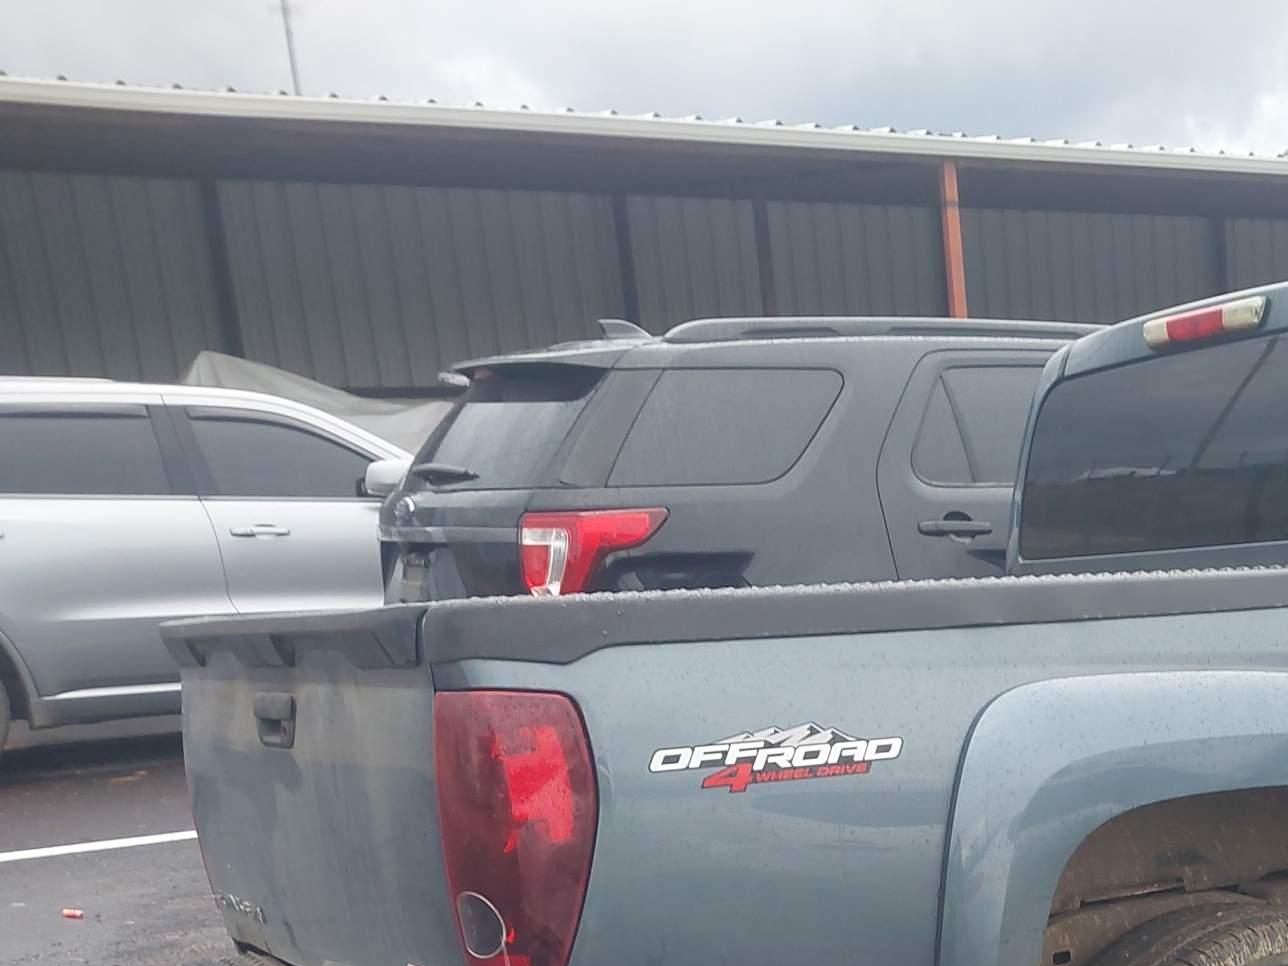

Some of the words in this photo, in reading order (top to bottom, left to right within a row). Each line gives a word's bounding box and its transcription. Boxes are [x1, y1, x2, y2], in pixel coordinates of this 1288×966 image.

[701, 763, 751, 793] 4
[756, 767, 814, 783] WHEEL
[816, 761, 868, 777] DRIVE
